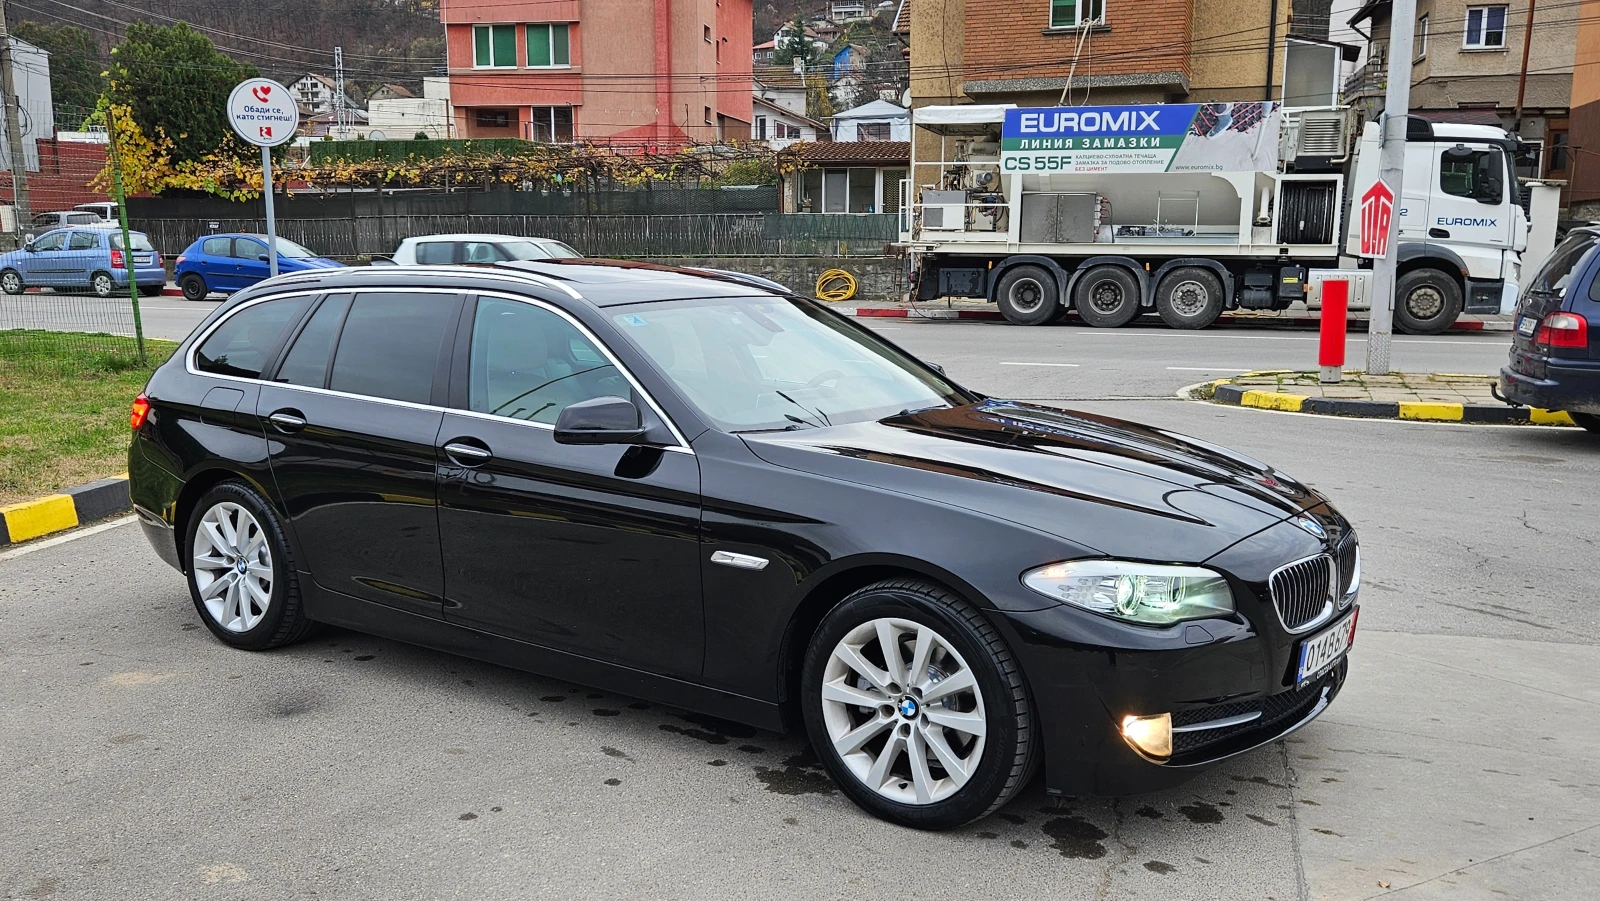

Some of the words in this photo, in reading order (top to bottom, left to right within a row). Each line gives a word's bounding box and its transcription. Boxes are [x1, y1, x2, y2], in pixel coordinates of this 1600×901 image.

[244, 106, 270, 114] Обади
[1020, 111, 1161, 132] EUROMIX
[1019, 139, 1073, 149] ЛИНИЯ
[1081, 137, 1161, 148] ЗАМАЗКИ
[1004, 156, 1031, 171] CS
[1034, 155, 1073, 170] 55F
[1437, 217, 1497, 227] EUROMIX
